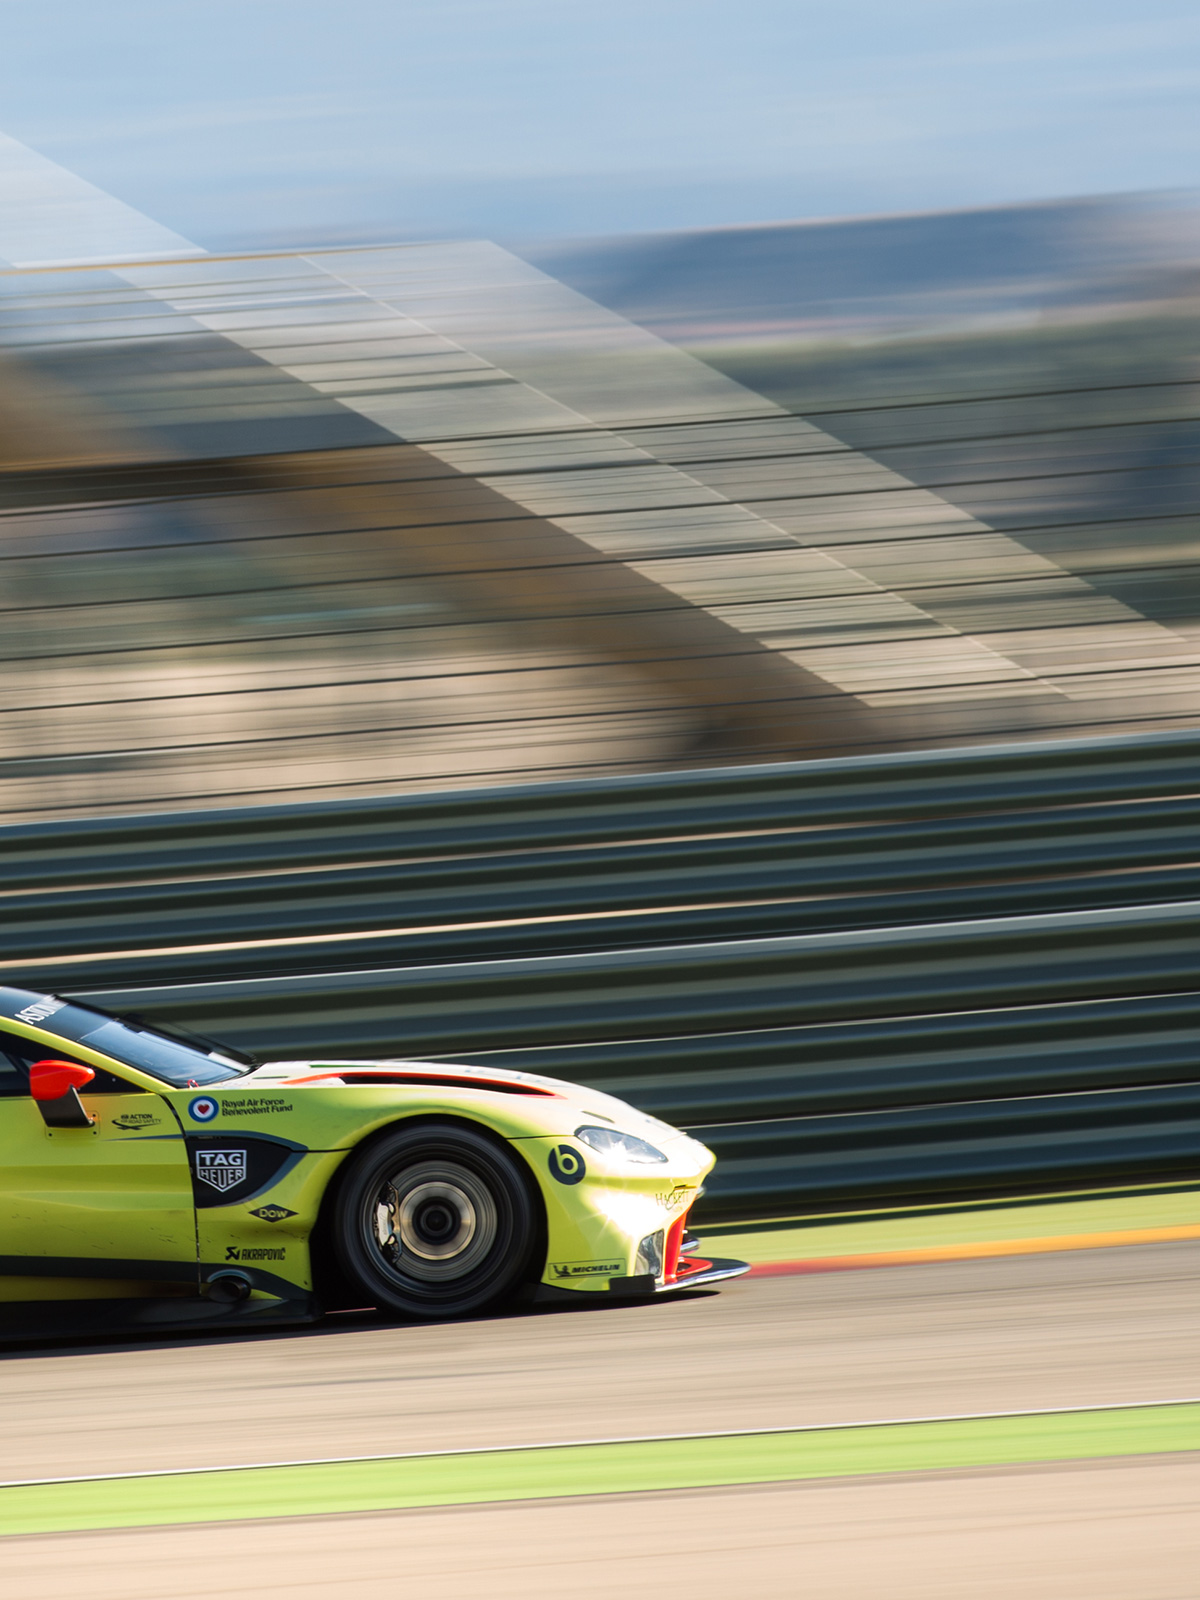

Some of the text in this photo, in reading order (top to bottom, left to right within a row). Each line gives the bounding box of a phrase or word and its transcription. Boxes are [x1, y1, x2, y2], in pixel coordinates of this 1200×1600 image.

[222, 1097, 285, 1109] Royal Air Force
[222, 1104, 293, 1117] Benevolent Fund
[201, 1153, 242, 1166] TAG
[200, 1169, 243, 1189] HEUER
[572, 1264, 621, 1273] MICHELIN
